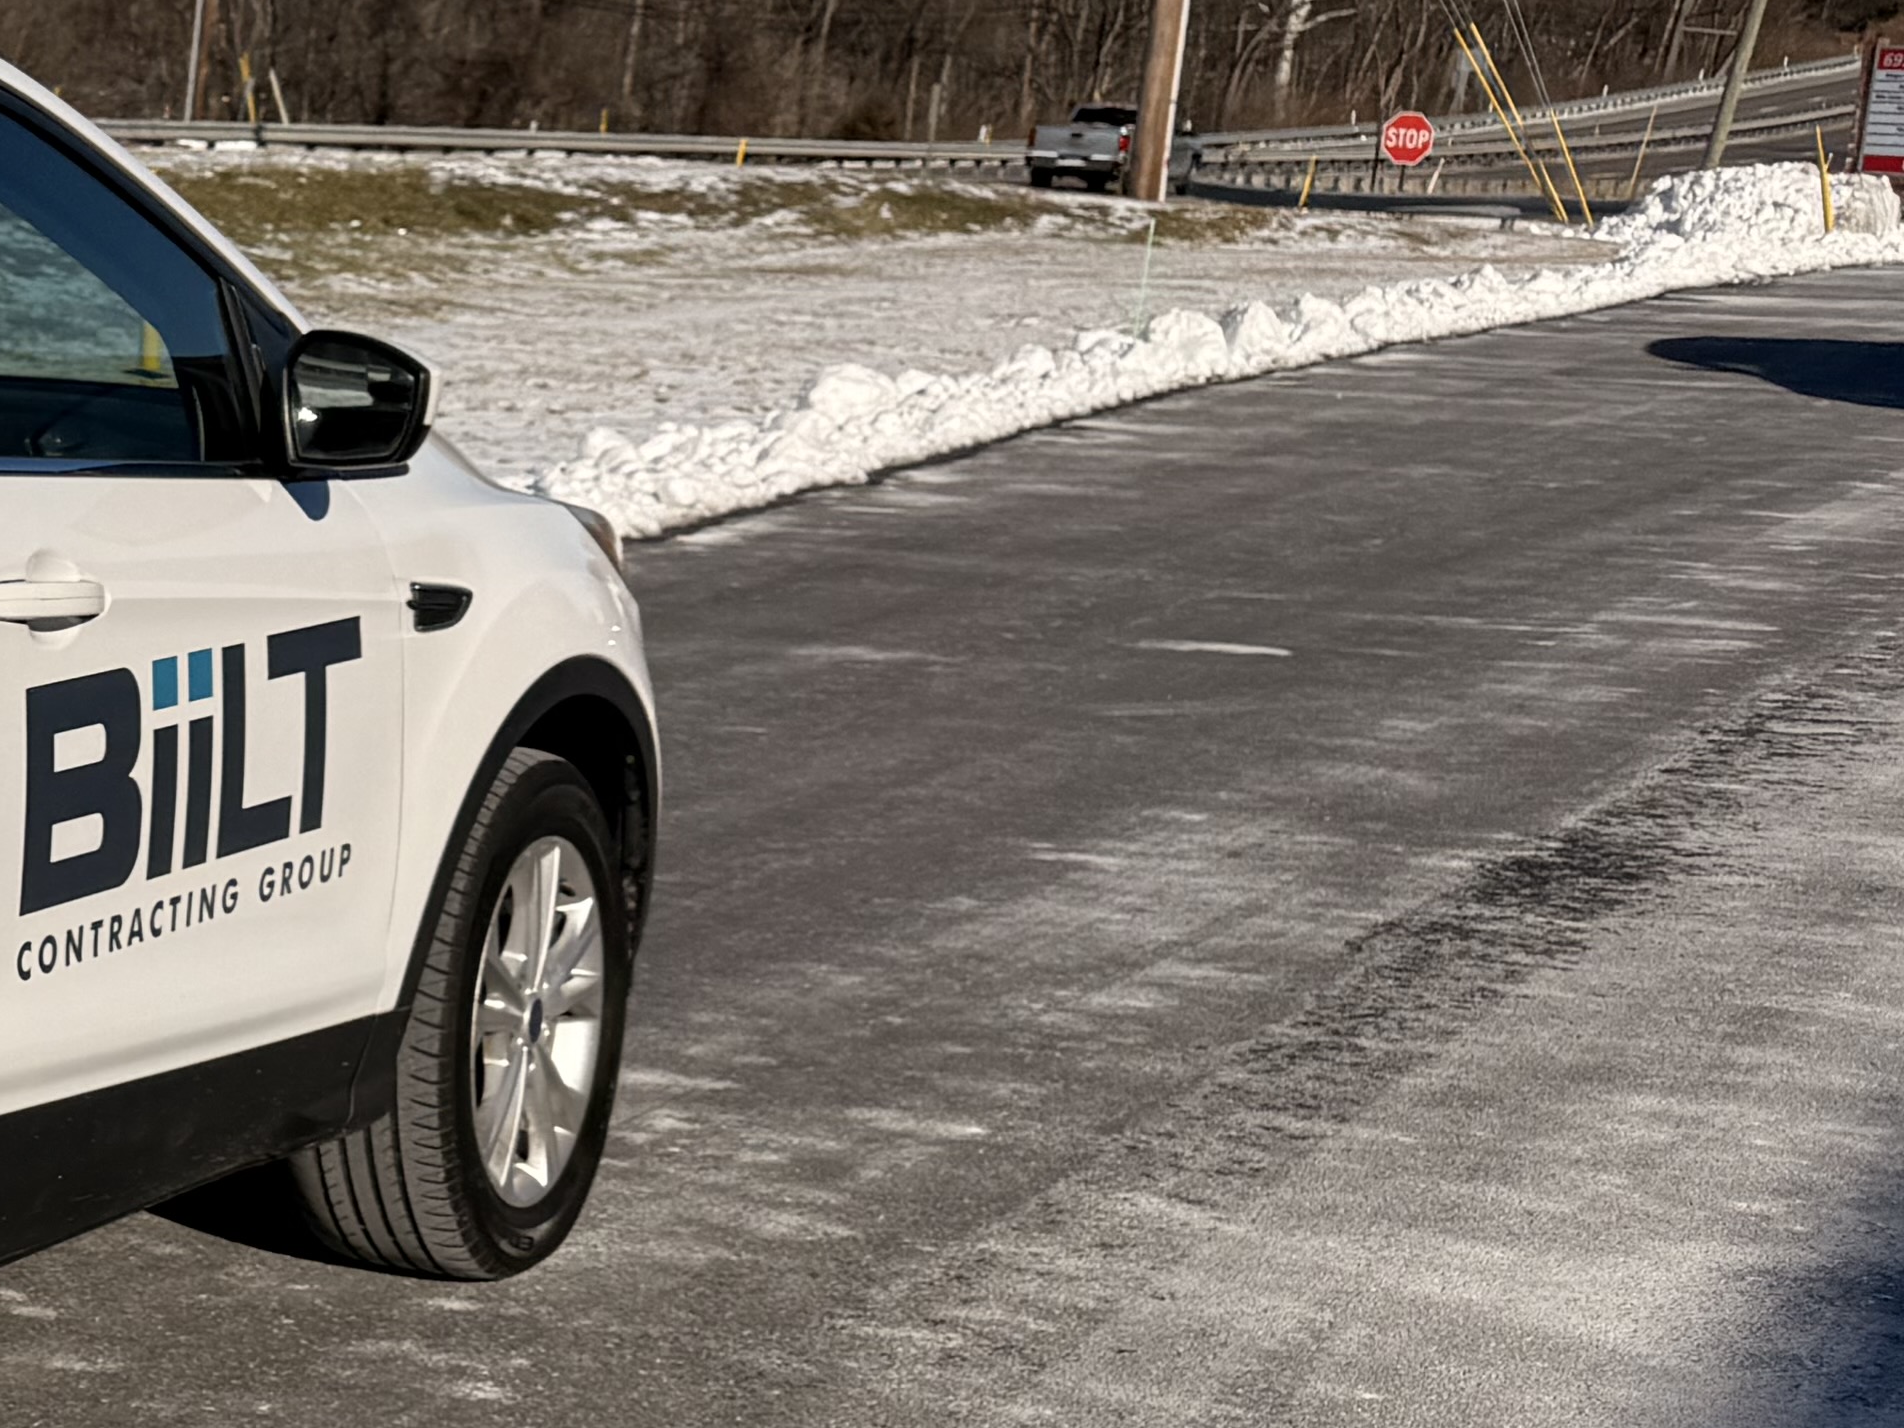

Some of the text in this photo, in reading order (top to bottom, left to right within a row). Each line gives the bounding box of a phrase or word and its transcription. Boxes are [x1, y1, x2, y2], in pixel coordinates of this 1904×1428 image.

[1386, 126, 1429, 149] STOP
[17, 842, 352, 981] CONTRACTING GROUP
